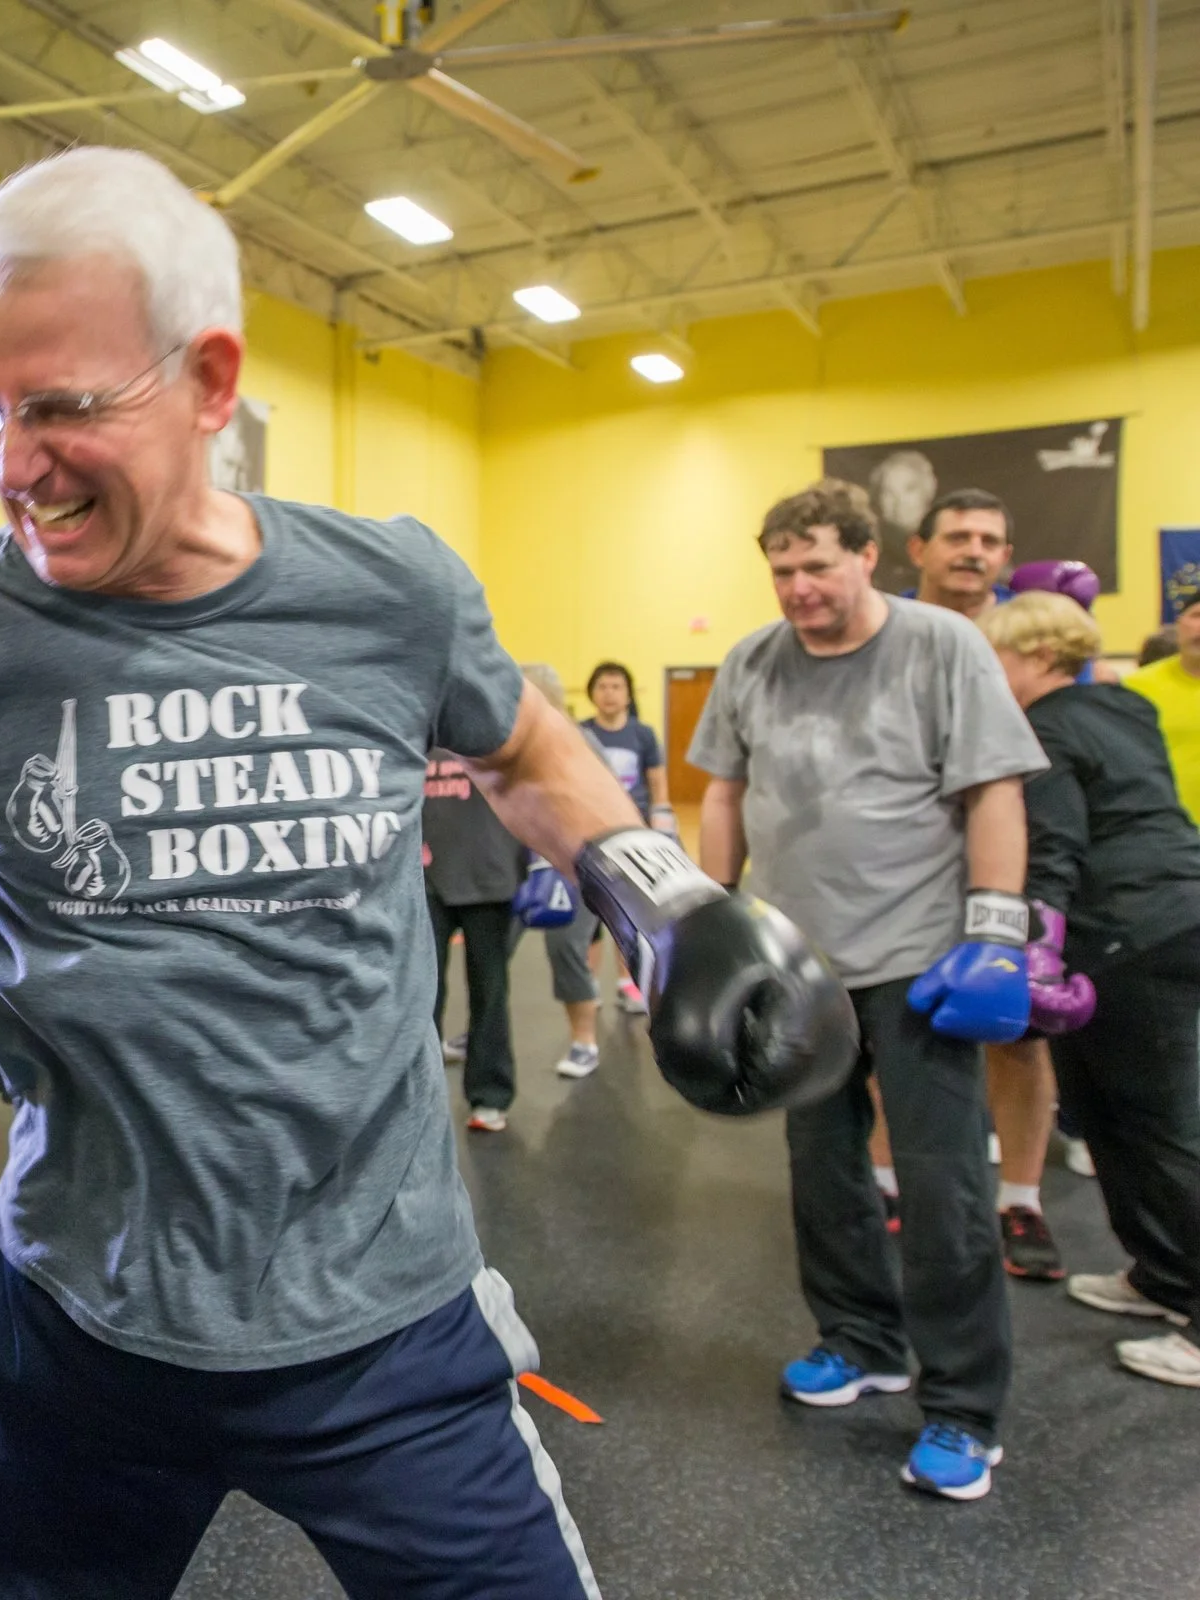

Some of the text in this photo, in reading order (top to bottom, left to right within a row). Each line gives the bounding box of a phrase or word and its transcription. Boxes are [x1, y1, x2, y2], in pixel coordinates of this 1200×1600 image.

[105, 683, 312, 749] ROCK
[121, 748, 385, 817] STEADY
[147, 811, 401, 880] BOXING
[183, 897, 264, 913] AGAINST
